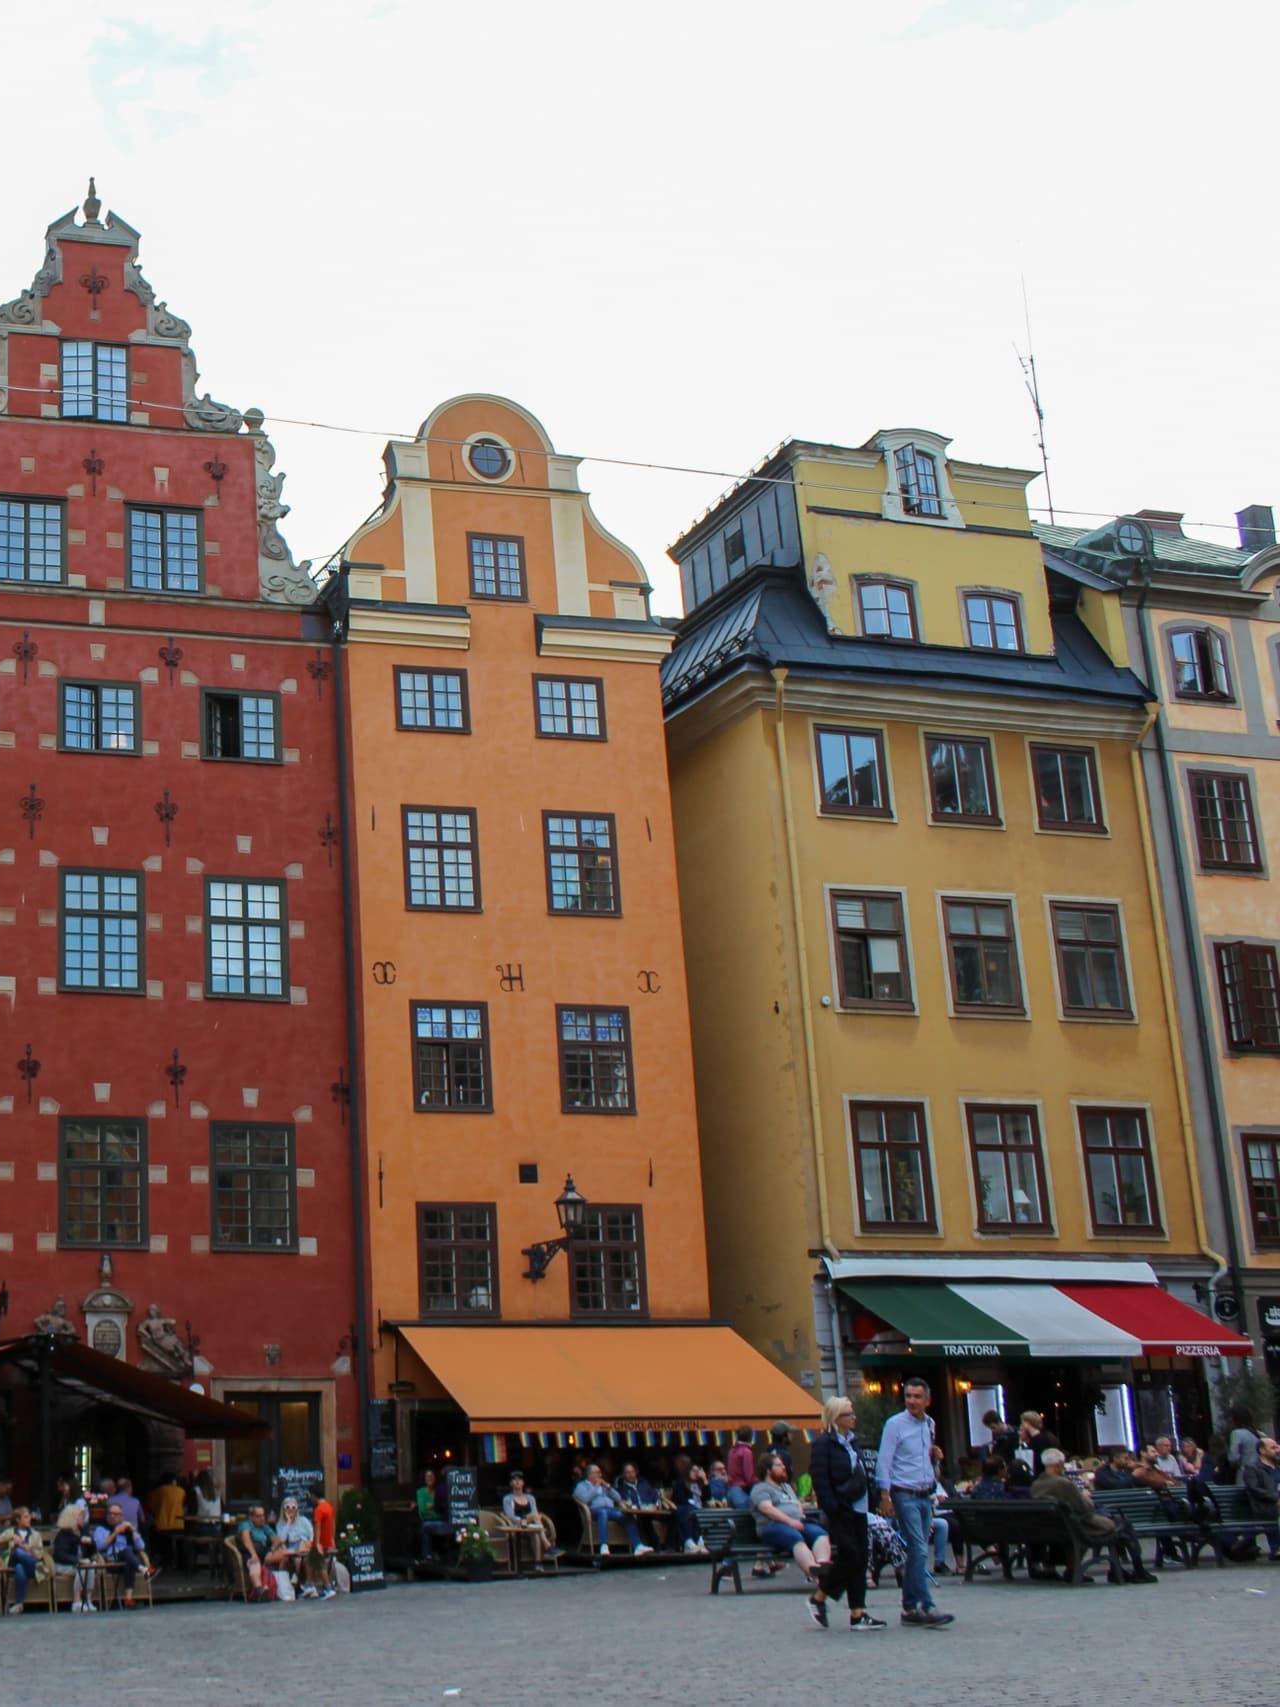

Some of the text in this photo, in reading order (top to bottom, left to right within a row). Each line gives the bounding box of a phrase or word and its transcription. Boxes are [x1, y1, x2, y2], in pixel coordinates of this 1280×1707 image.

[943, 1344, 1001, 1357] TRATTORIA
[1175, 1345, 1222, 1357] PIZZERIA
[613, 1421, 700, 1431] CHOKLADKOPPEN
